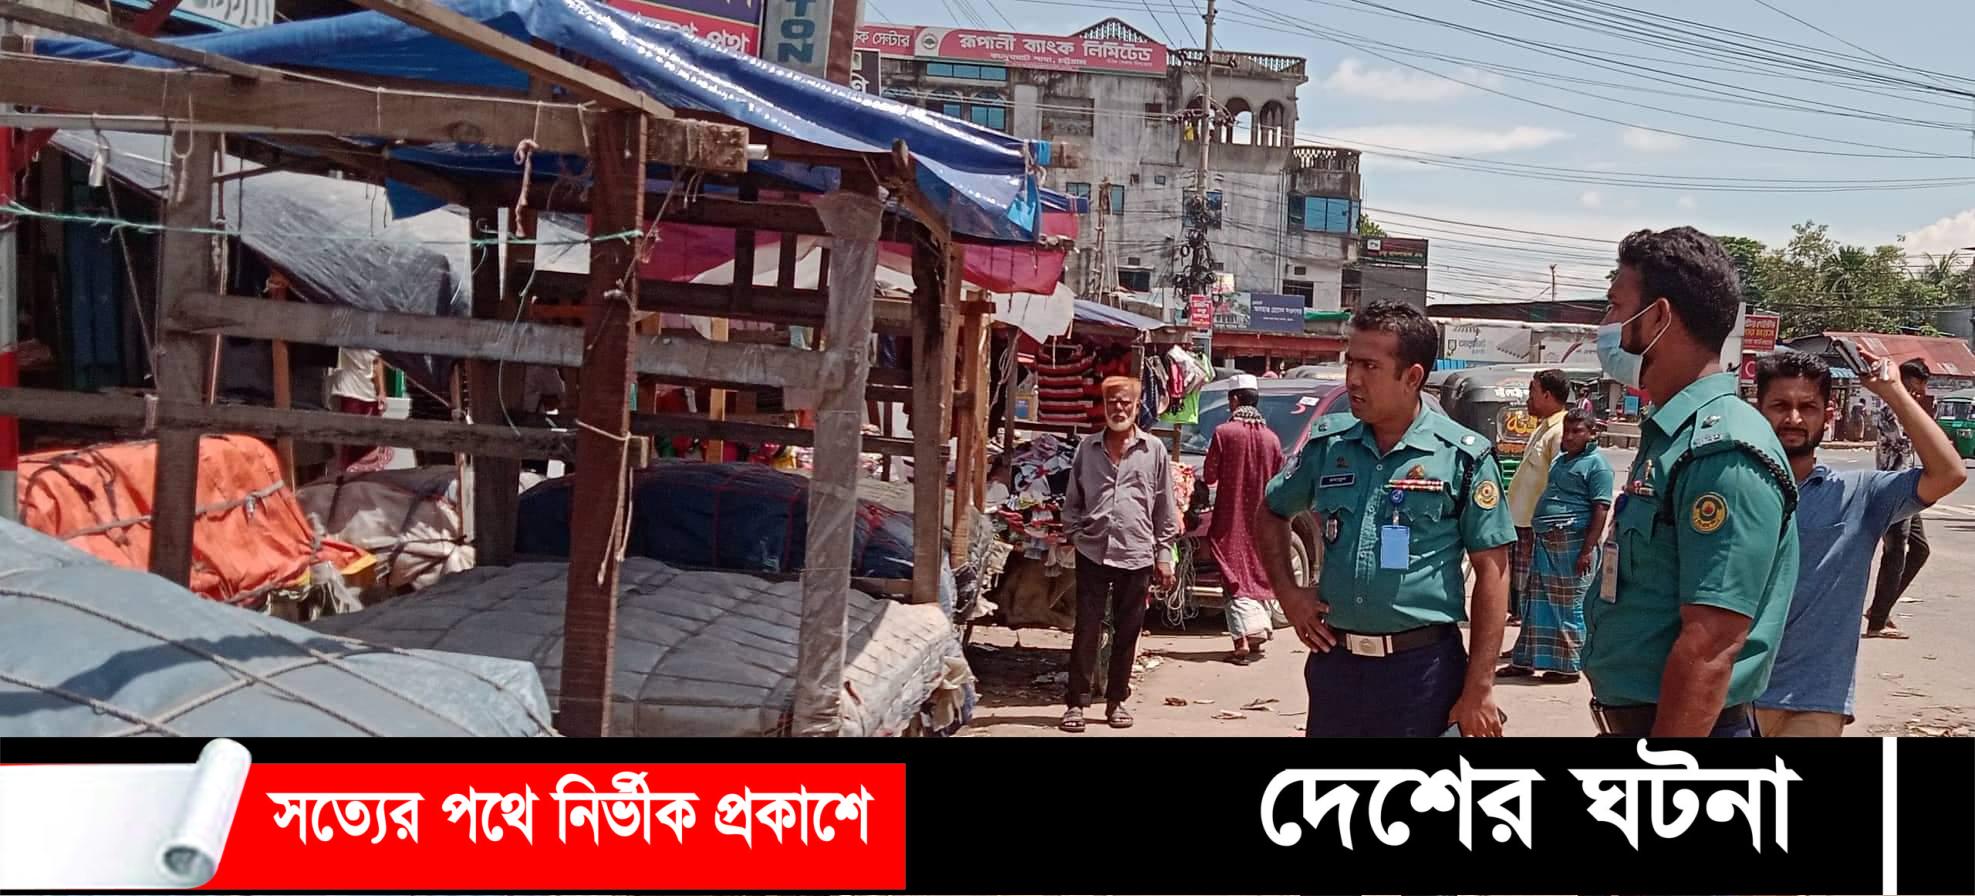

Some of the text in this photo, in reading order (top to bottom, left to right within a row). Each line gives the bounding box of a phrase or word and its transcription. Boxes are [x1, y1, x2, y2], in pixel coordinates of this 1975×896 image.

[873, 30, 911, 48] সেন্টার
[958, 33, 1153, 61] রূপালী ব্যাংক লিমিটেড
